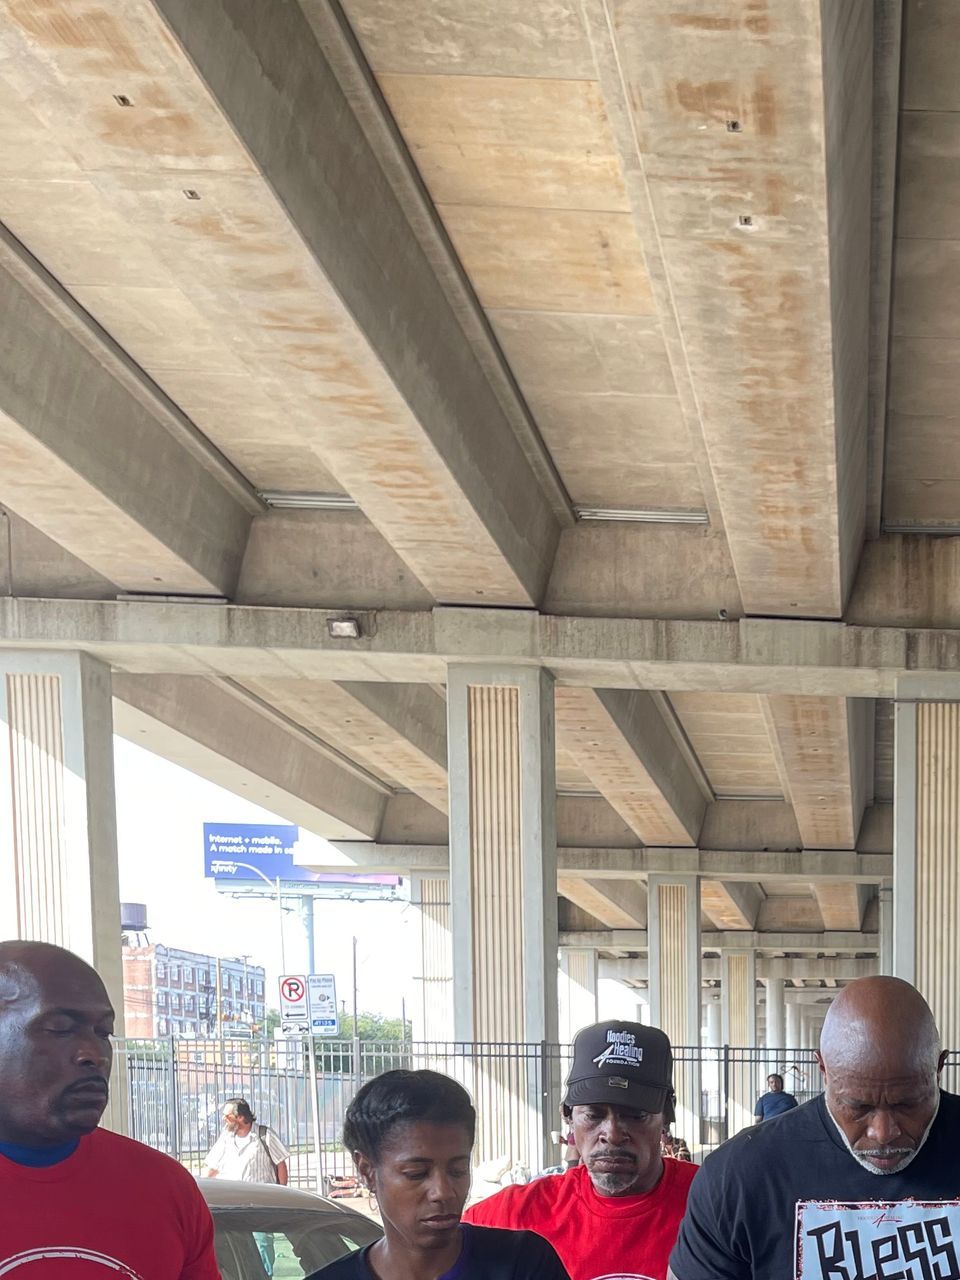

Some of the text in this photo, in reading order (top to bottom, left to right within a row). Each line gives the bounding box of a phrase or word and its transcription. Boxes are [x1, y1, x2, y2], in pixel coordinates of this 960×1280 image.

[209, 834, 243, 844] Internet
[209, 844, 217, 852] A
[218, 844, 247, 854] match
[248, 845, 273, 854] made
[274, 845, 283, 854] in
[606, 1030, 636, 1044] Hoodies
[613, 1042, 643, 1061] Healing
[606, 1059, 640, 1067] FOUNDATION
